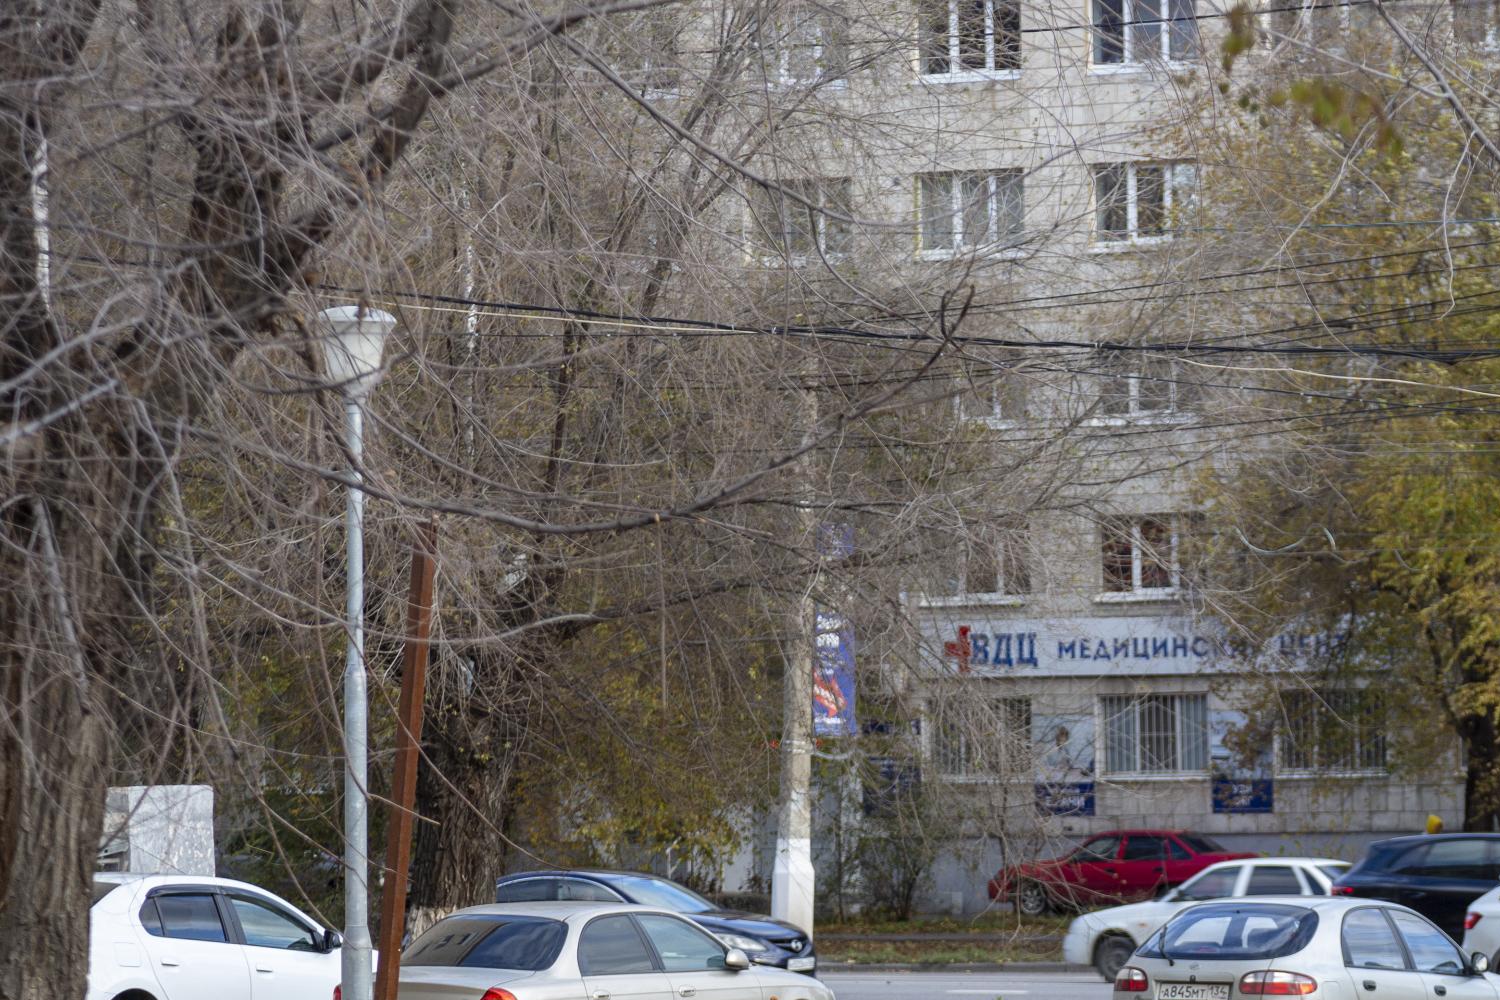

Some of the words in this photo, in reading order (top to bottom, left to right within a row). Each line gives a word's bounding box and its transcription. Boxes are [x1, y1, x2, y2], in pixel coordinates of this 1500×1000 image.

[970, 632, 1038, 667] ВДЦ
[1162, 985, 1206, 999] А845МТ
[1209, 985, 1228, 996] 134
